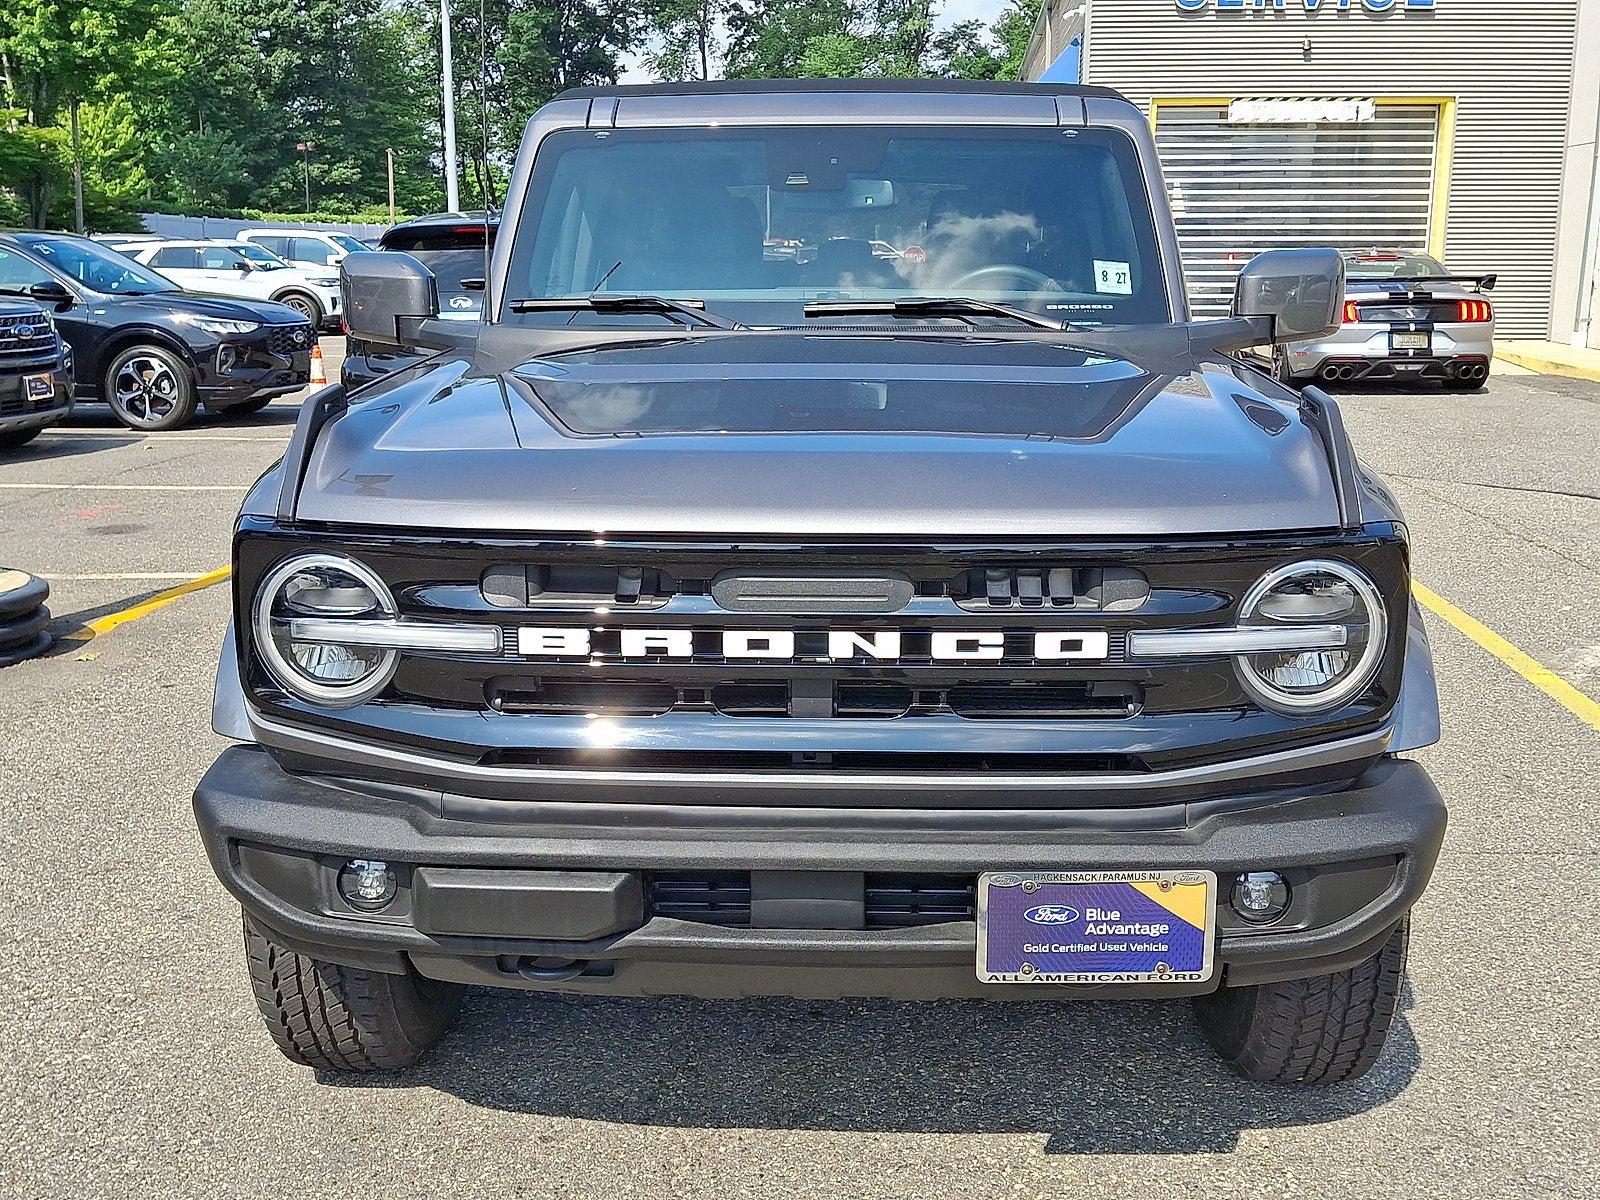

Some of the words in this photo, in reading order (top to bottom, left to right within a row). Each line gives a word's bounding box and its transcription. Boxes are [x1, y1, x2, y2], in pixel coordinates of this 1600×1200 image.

[1101, 270, 1108, 282] 8
[1115, 272, 1127, 284] 27
[517, 627, 1109, 660] BRONCO
[1148, 872, 1161, 880] NJ
[1034, 907, 1069, 922] Ford
[1085, 908, 1121, 921] Blue
[1084, 923, 1170, 937] Advantage
[1023, 943, 1049, 953] Gold
[1051, 943, 1097, 953] Certified
[1099, 942, 1127, 952] Used
[1129, 942, 1169, 952] Vehicle
[987, 974, 1020, 982] ALL
[1034, 974, 1140, 982] AMERICAN
[1146, 973, 1203, 981] FORD
